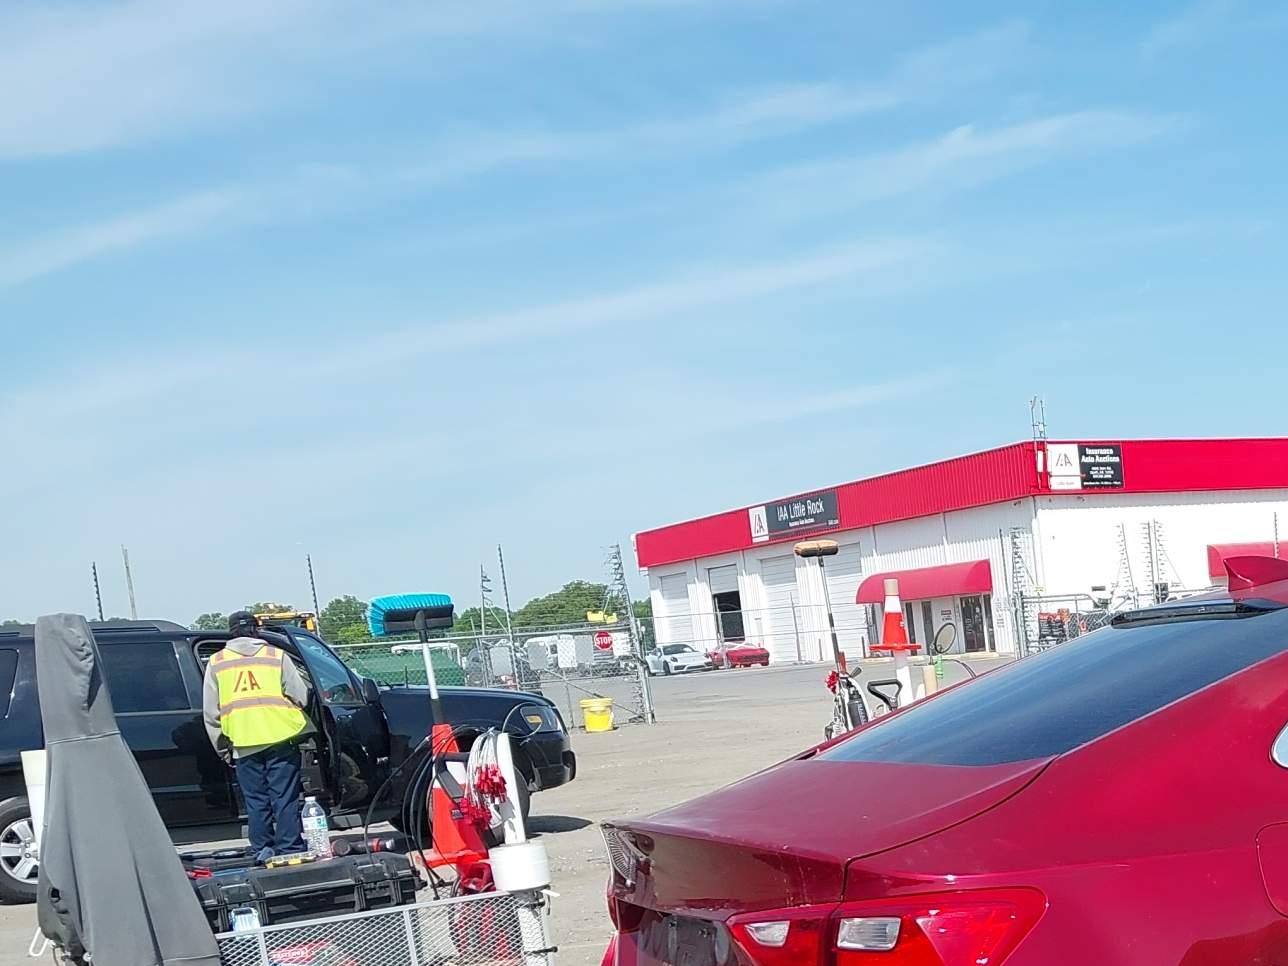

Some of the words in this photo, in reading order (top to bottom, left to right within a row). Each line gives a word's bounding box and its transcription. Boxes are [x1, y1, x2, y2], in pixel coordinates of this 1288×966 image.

[777, 506, 789, 522] IAA
[789, 500, 806, 519] Little
[806, 497, 825, 516] Rock
[596, 636, 612, 645] STOP
